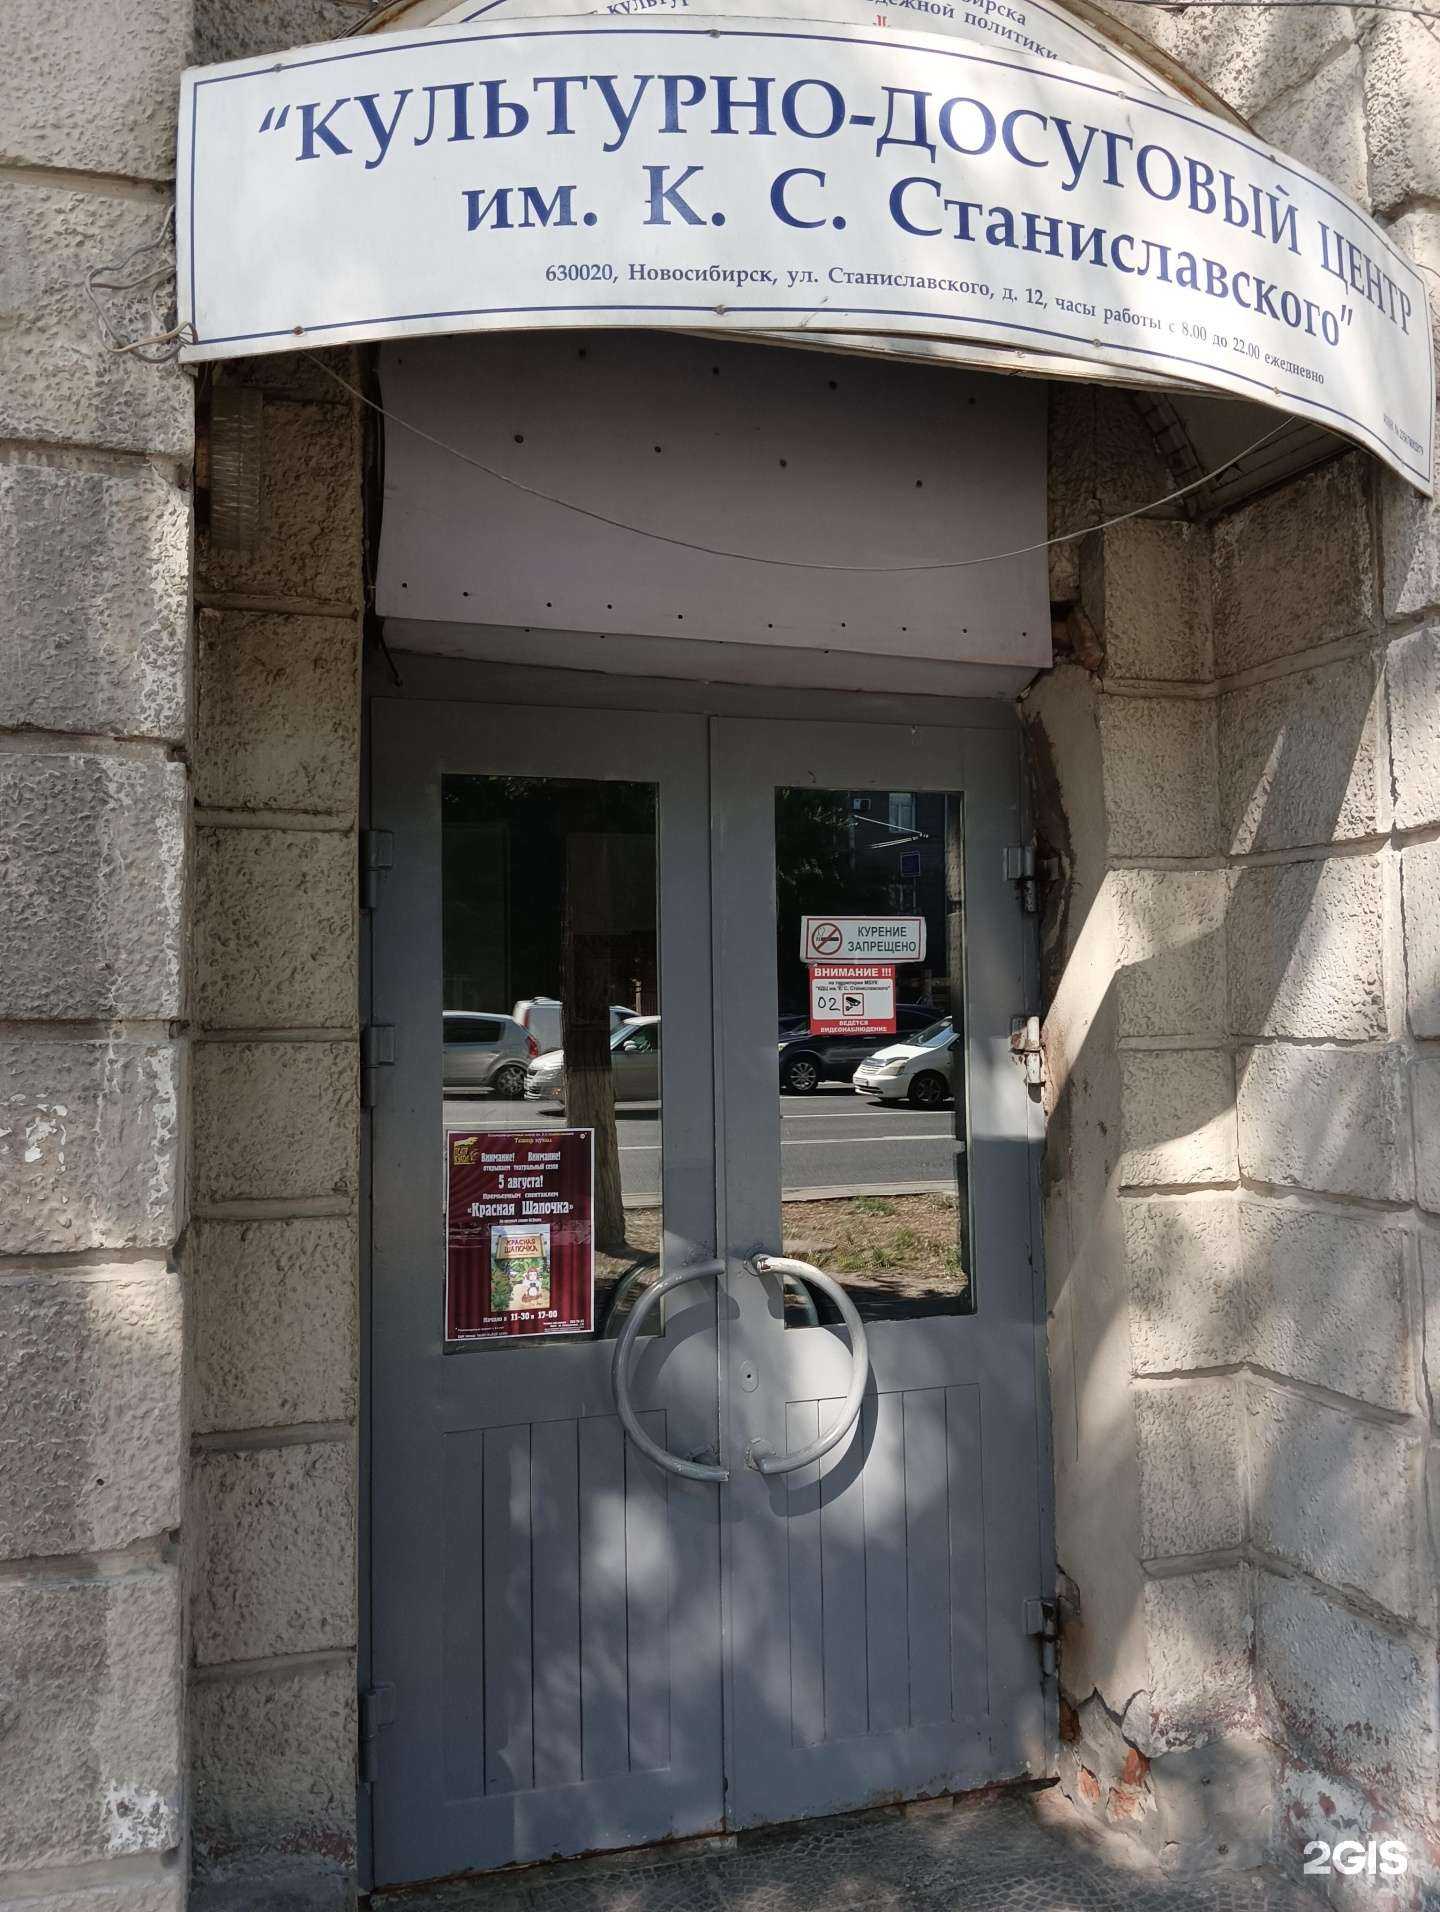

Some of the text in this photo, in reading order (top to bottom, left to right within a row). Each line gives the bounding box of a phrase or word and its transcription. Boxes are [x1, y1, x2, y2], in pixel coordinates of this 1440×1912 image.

[965, 12, 1058, 60] политики
[461, 185, 599, 232] им.
[642, 165, 727, 227] К.
[770, 168, 847, 230] С.
[1317, 220, 1412, 335] ЦЕНТР
[545, 264, 1325, 386] 630020, Новосибирск, ул. Станиславского, д. 12, часы работы с 8.00 до 22.00 ежедневно
[858, 926, 907, 938] КУРЕНИЕ
[847, 941, 917, 954] ЗАПРЕЩЕНО
[814, 968, 892, 977] ВНИМАНИЕ !!!
[498, 1174, 544, 1189] 5 августа!
[468, 1200, 574, 1218] «Красная Шапочка»
[510, 1312, 530, 1321] 11-30
